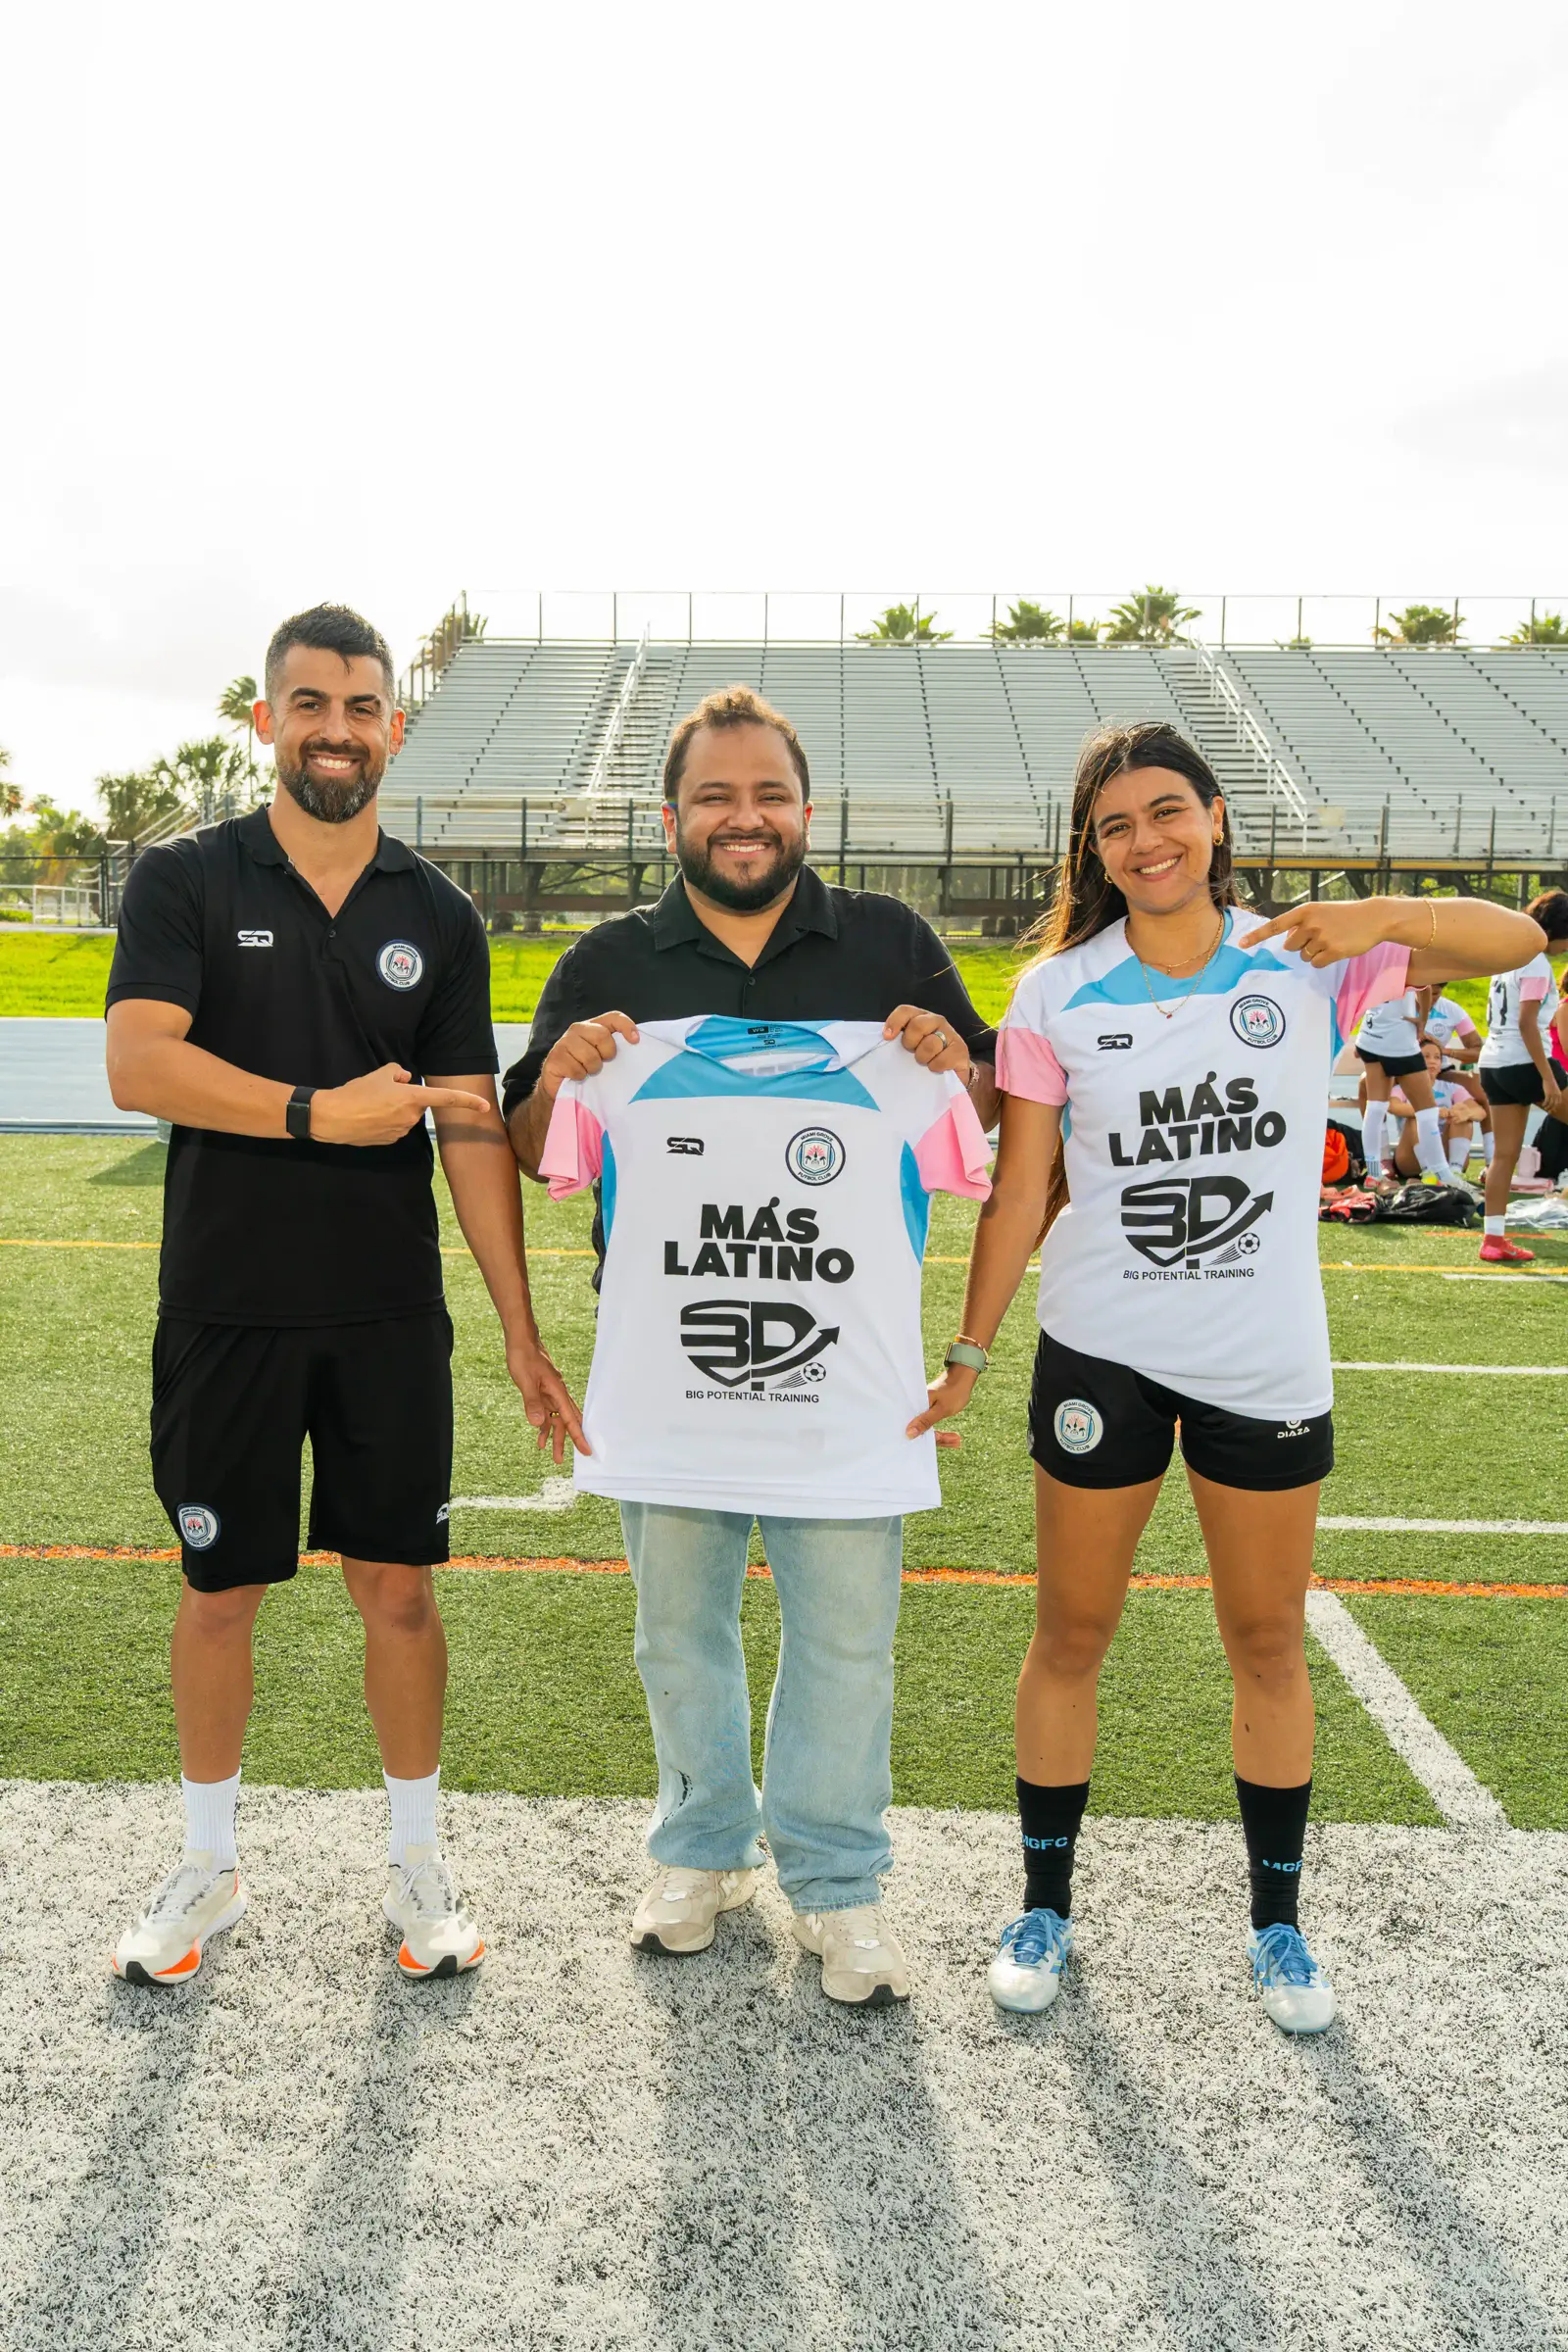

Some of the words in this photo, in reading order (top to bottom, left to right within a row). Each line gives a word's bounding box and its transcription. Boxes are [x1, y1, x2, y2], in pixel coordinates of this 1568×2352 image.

[237, 930, 274, 948] SQ
[1238, 999, 1252, 1009] MIAMI
[1252, 998, 1270, 1006] GROVE
[1097, 1033, 1134, 1052] SQ
[1247, 1036, 1267, 1045] FUTBOL
[1266, 1034, 1278, 1043] CLUB
[1139, 1070, 1259, 1127] MÁS
[800, 1131, 815, 1141] MIAMI
[816, 1131, 834, 1142] GROVE
[1108, 1110, 1287, 1167] LATINO
[666, 1136, 705, 1156] SQ
[798, 1171, 818, 1181] FUTBOL
[817, 1172, 832, 1181] CLUB
[700, 1196, 819, 1245] MÁS
[663, 1241, 856, 1284] LATINO
[1123, 1270, 1140, 1281] BIG
[1142, 1271, 1201, 1281] POTENTIAL
[1203, 1267, 1255, 1281] TRAINING
[685, 1390, 705, 1399] BIG
[707, 1392, 766, 1401] POTENTIAL
[768, 1393, 820, 1403] TRAINING
[1078, 1402, 1095, 1414] GROVE
[1277, 1426, 1310, 1439] DIAZA
[1059, 1438, 1076, 1451] FUTBOL
